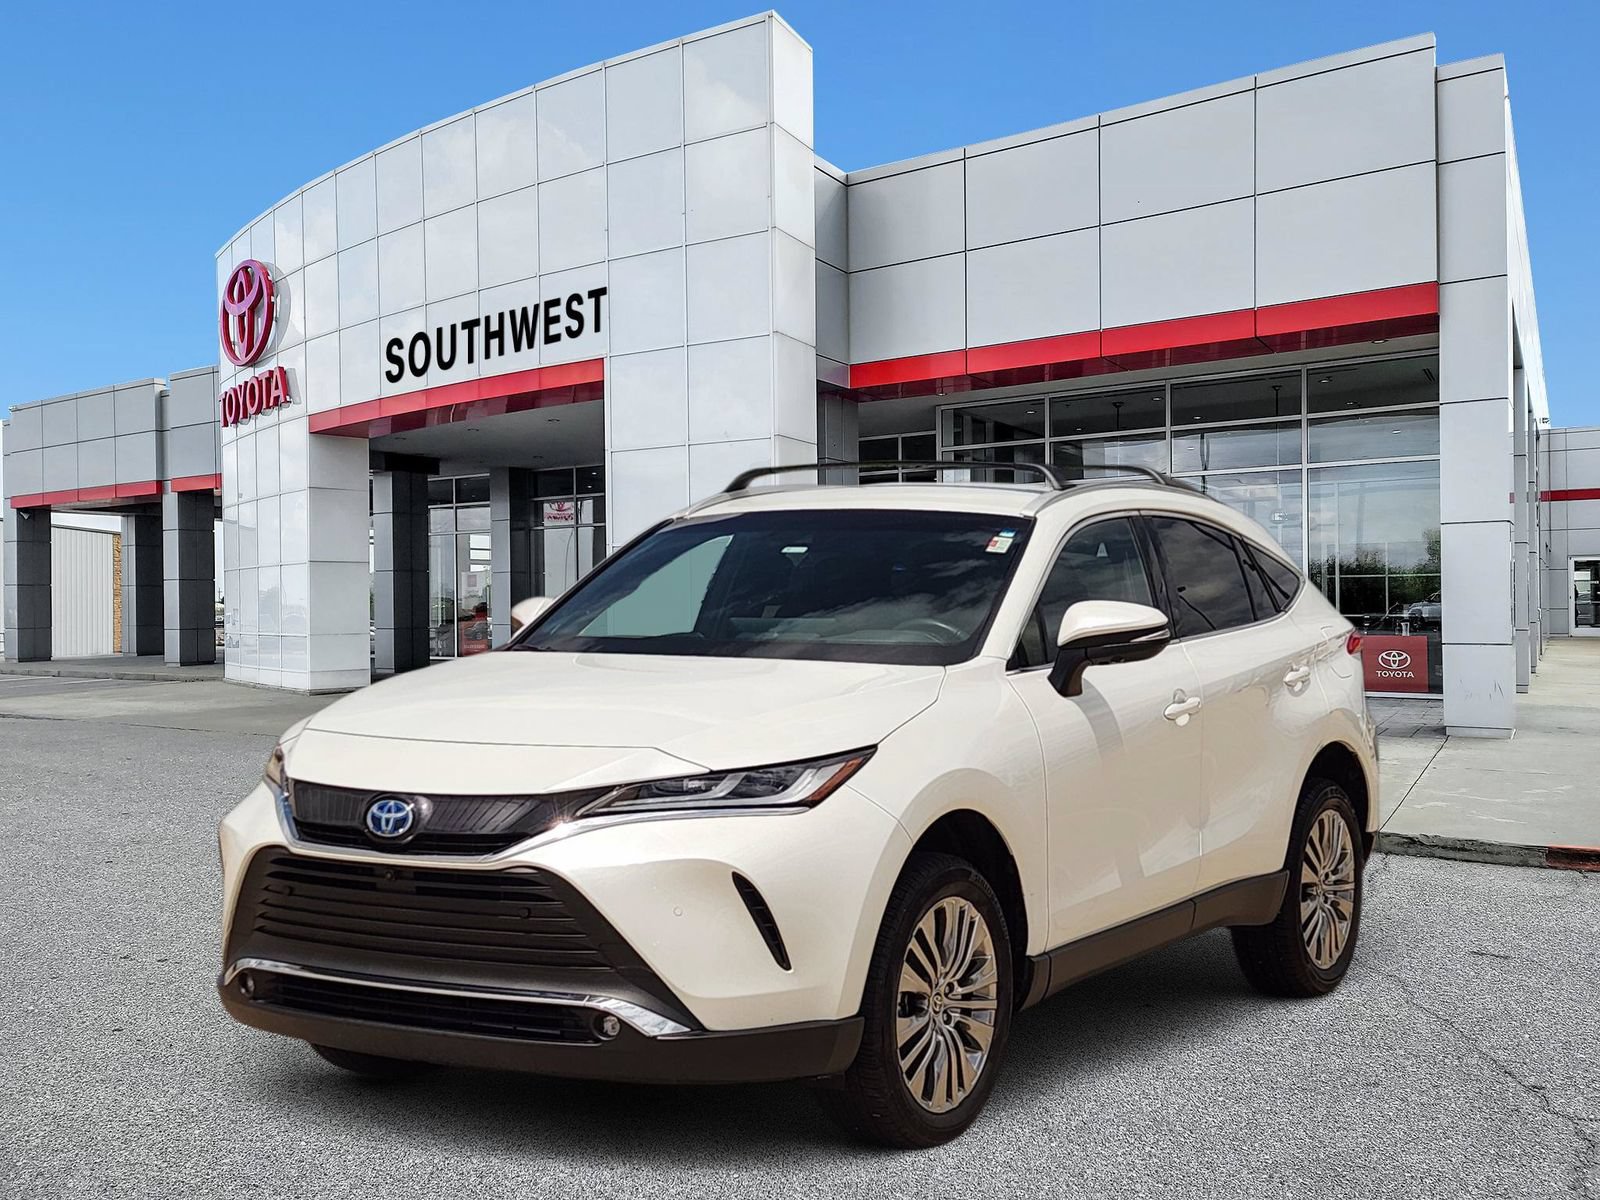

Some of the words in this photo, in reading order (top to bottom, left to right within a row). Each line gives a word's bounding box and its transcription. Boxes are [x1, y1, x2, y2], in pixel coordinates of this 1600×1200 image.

[385, 287, 608, 383] SOUTHWEST
[219, 366, 290, 428] TOYOTA
[1376, 670, 1415, 678] TOYOTA
